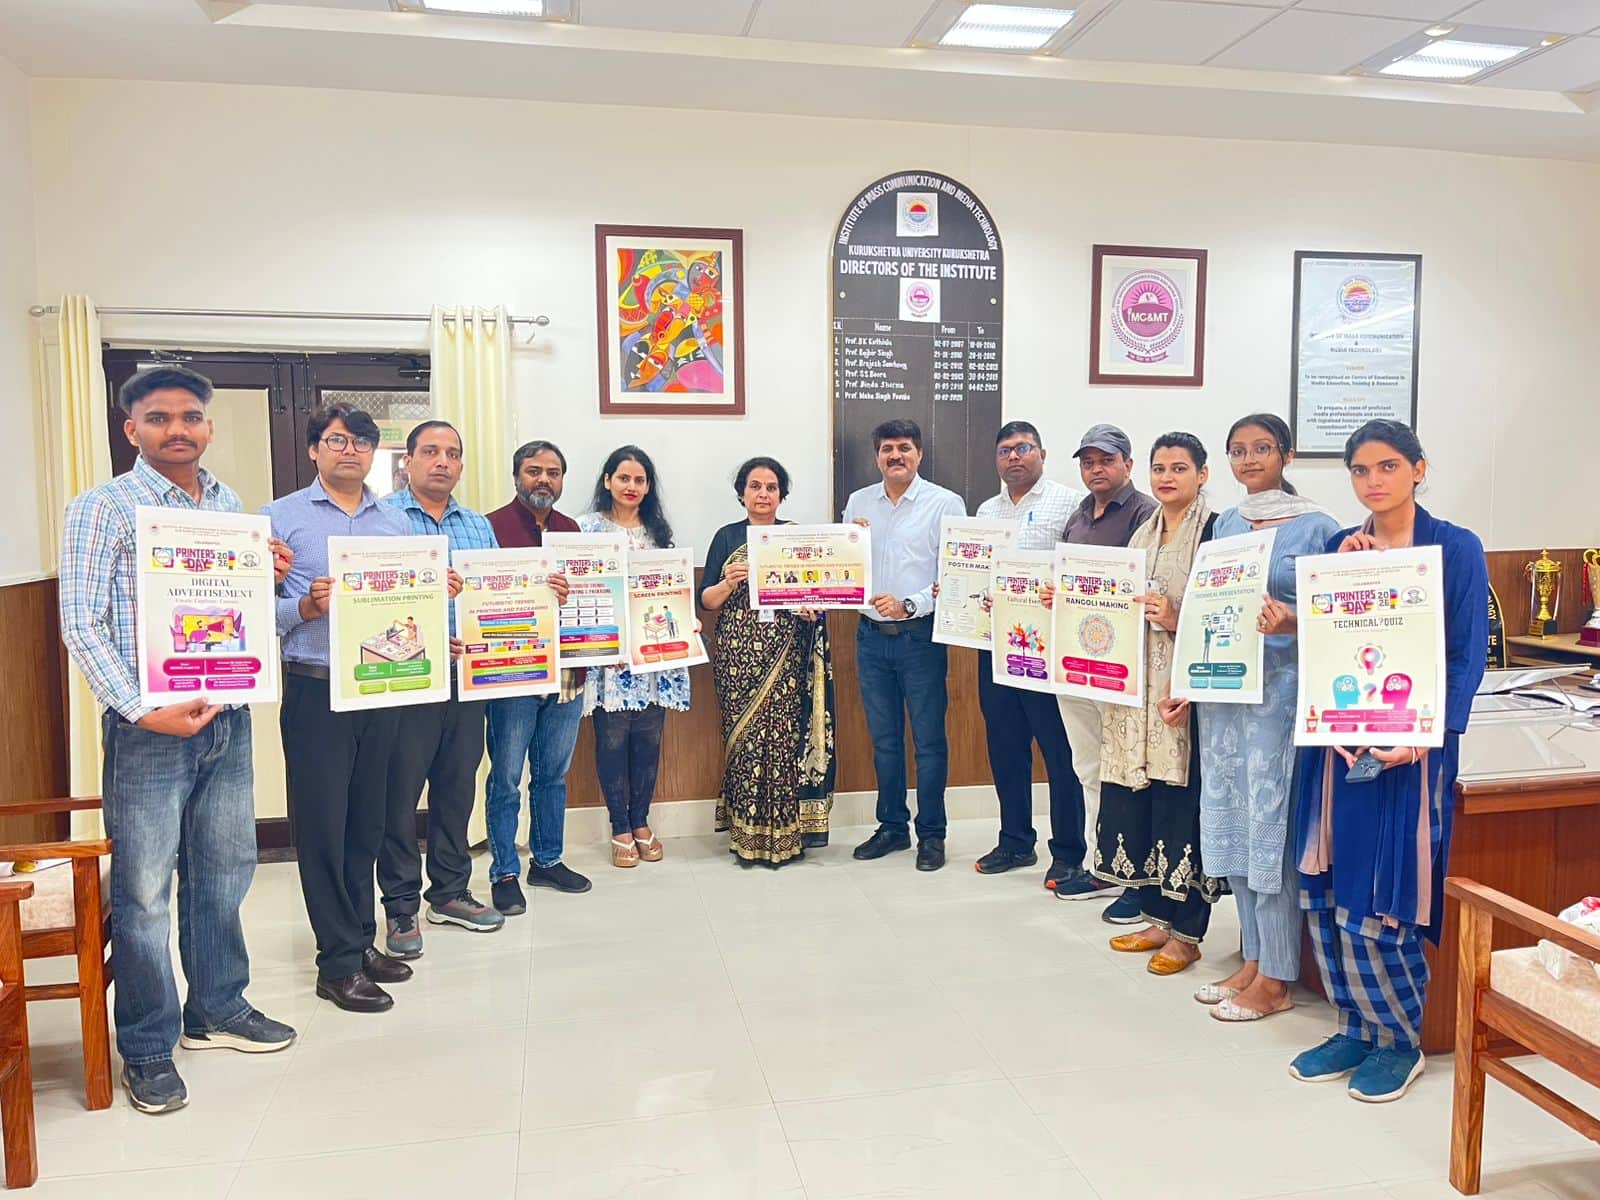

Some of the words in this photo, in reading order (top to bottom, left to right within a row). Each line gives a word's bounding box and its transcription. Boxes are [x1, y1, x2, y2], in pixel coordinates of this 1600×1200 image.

[838, 207, 862, 245] INSTITUTE
[858, 197, 869, 210] OF
[867, 184, 887, 203] MASS
[883, 174, 942, 192] COMMUNICATION
[941, 181, 955, 196] AND
[954, 188, 975, 210] MEDIA
[971, 204, 999, 250] TECHNOLOGY
[849, 245, 901, 257] KURUKSHETRA
[902, 247, 942, 260] UNIVERSITY
[942, 249, 990, 261] KURUKSHETRA
[840, 260, 899, 275] DIRECTORS
[900, 261, 915, 276] OF
[919, 263, 938, 277] THE
[940, 264, 997, 280] INSTITUTE
[176, 547, 216, 559] PRINTERS
[217, 552, 227, 560] 20
[187, 559, 209, 572] DAY
[363, 570, 398, 580] PRINTERS
[1075, 575, 1102, 586] PRINTERS
[191, 578, 232, 587] DIGITAL
[375, 580, 391, 591] DAY
[167, 588, 254, 598] ADVERTISEMENT
[353, 596, 401, 604] SUBLIMATION
[402, 593, 434, 601] PRINTING
[1334, 589, 1376, 602] PRINTERS
[1066, 597, 1098, 606] RANGOLI
[1100, 600, 1129, 610] MAKING
[1346, 601, 1368, 614] DAY
[1333, 619, 1379, 629] TECHNICAL
[1385, 617, 1404, 627] QUIZ
